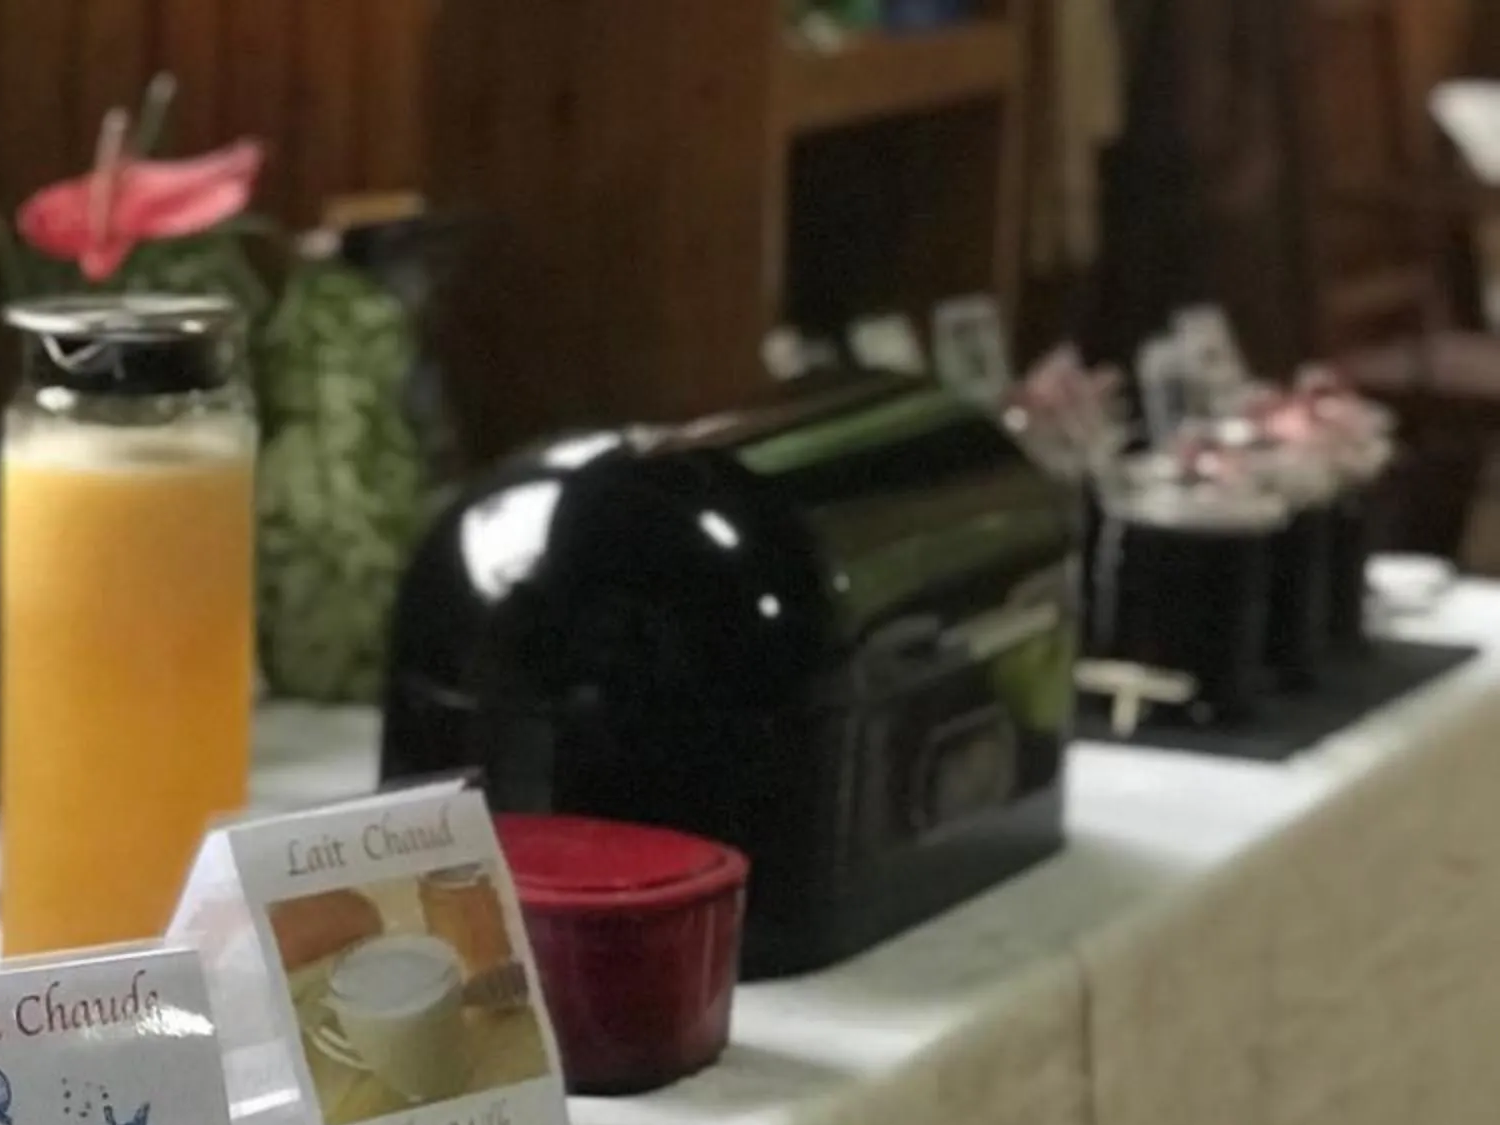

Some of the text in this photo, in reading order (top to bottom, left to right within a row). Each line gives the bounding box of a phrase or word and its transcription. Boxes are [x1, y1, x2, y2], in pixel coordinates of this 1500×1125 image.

[285, 801, 456, 878] Lait Chaud
[15, 970, 161, 1037] Chaude
